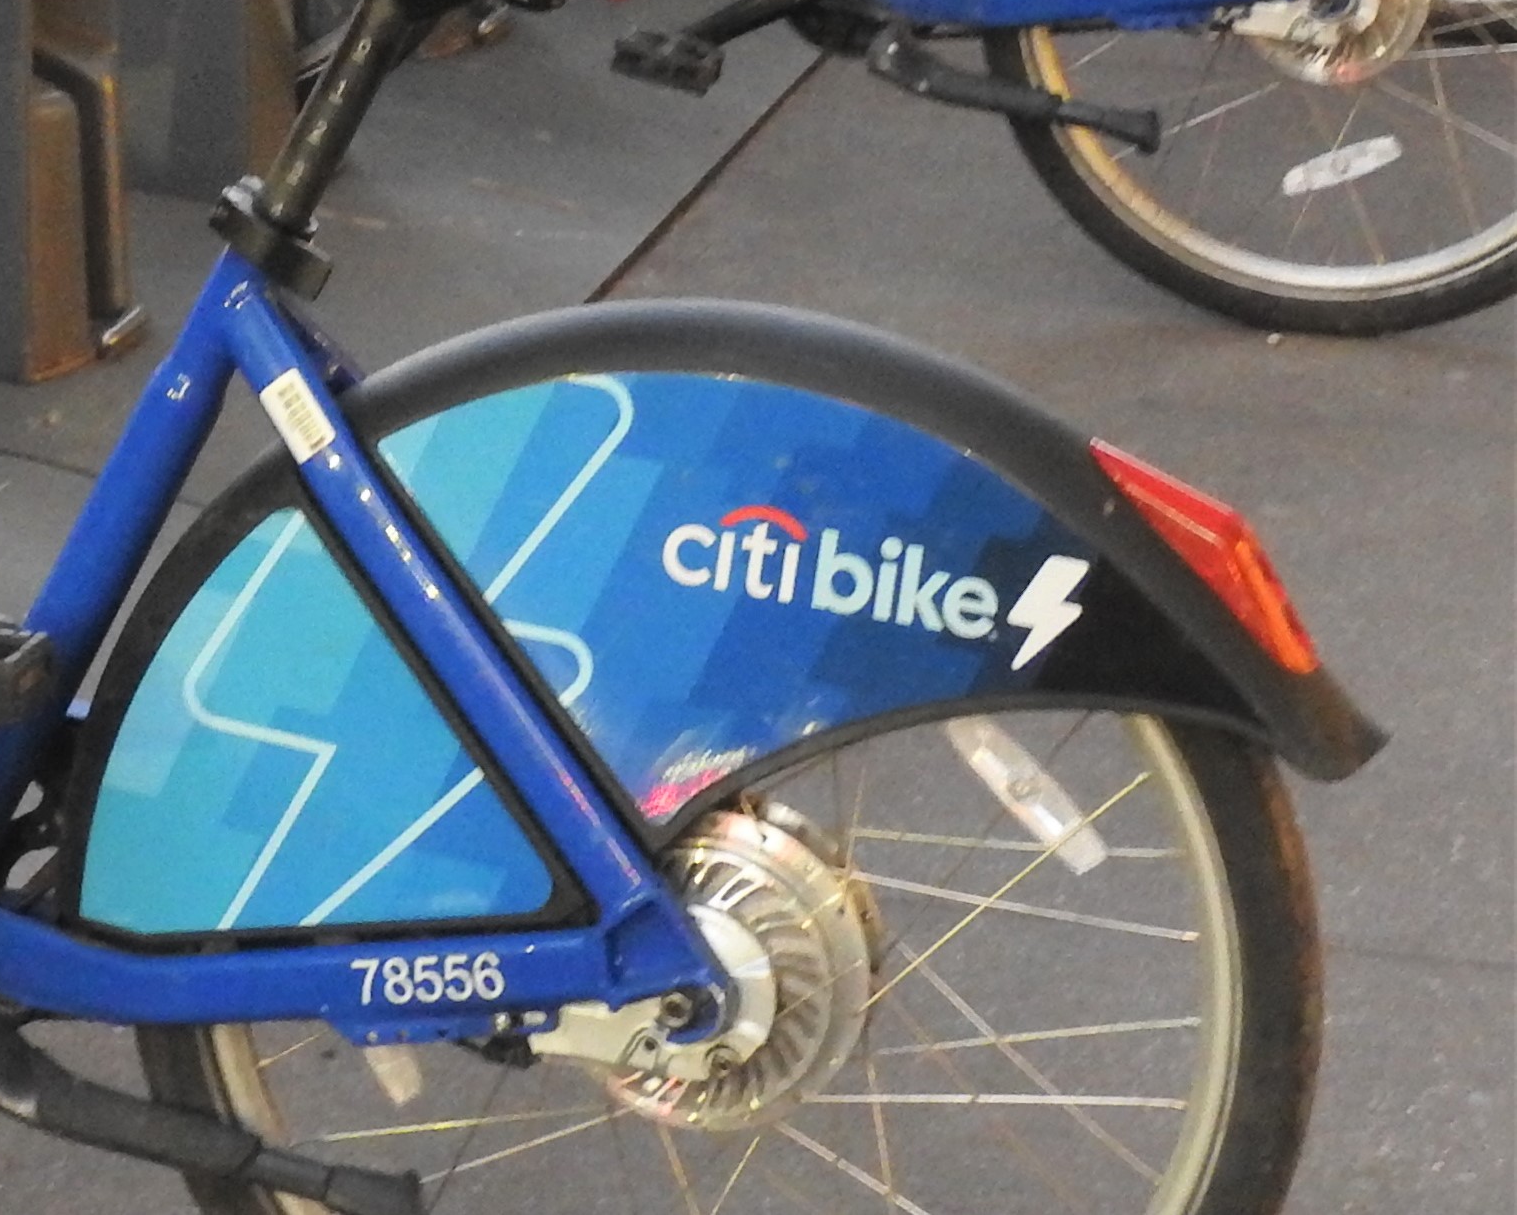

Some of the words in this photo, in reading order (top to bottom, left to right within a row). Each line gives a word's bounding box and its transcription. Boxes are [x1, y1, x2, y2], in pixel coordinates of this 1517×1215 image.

[661, 504, 807, 605] citi
[810, 527, 999, 640] bike
[349, 950, 506, 1006] 78556
